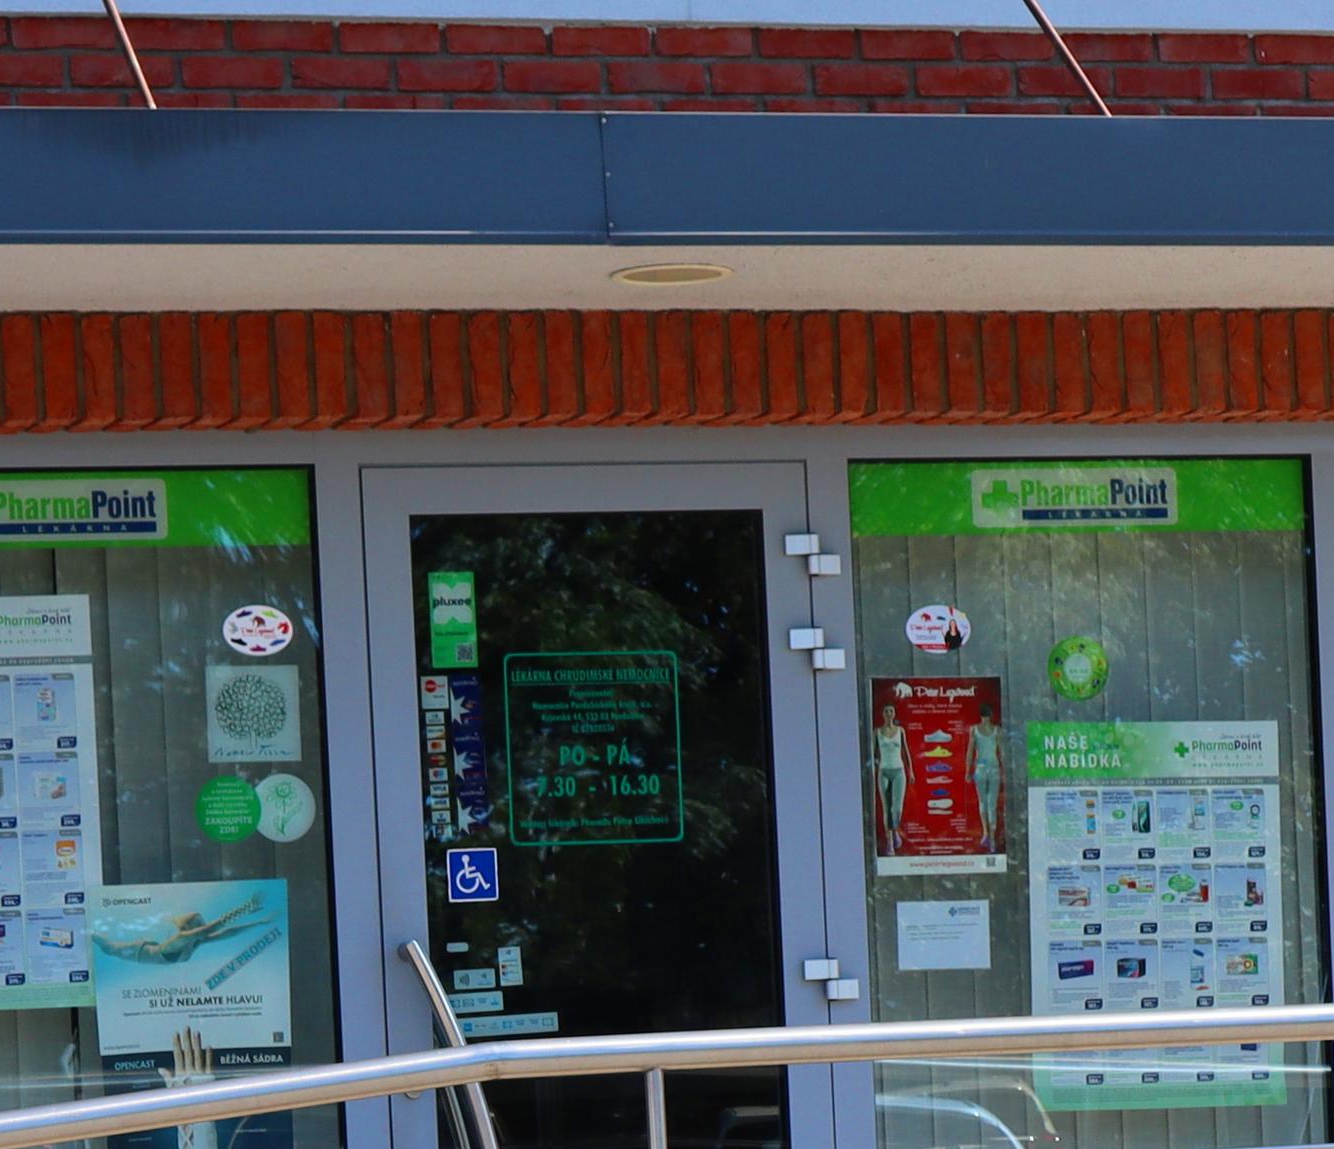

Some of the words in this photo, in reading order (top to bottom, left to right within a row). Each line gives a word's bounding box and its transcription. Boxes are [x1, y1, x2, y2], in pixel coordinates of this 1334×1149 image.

[1021, 478, 1168, 506] PharmaPoint
[617, 667, 670, 681] NEMOCNICE
[1044, 732, 1088, 750] NAŠE
[1192, 738, 1263, 752] PharmaPoint
[559, 744, 586, 766] PO
[606, 737, 631, 765] PÁ
[1045, 751, 1122, 768] NABÍDKA
[537, 776, 576, 797] 7.30
[610, 774, 660, 796] 16.30
[113, 897, 151, 906] OPENCAST
[122, 989, 133, 999] SE
[134, 986, 202, 999] ZLOMENINAMI
[149, 999, 158, 1008] SI
[159, 996, 173, 1008] UŽ
[176, 997, 224, 1008] NELAMTE
[226, 995, 263, 1006] HLAVU!
[220, 1051, 251, 1064] BĚŽNÁ
[252, 1051, 284, 1063] SÁDRA
[114, 1059, 155, 1071] OPENCAST
